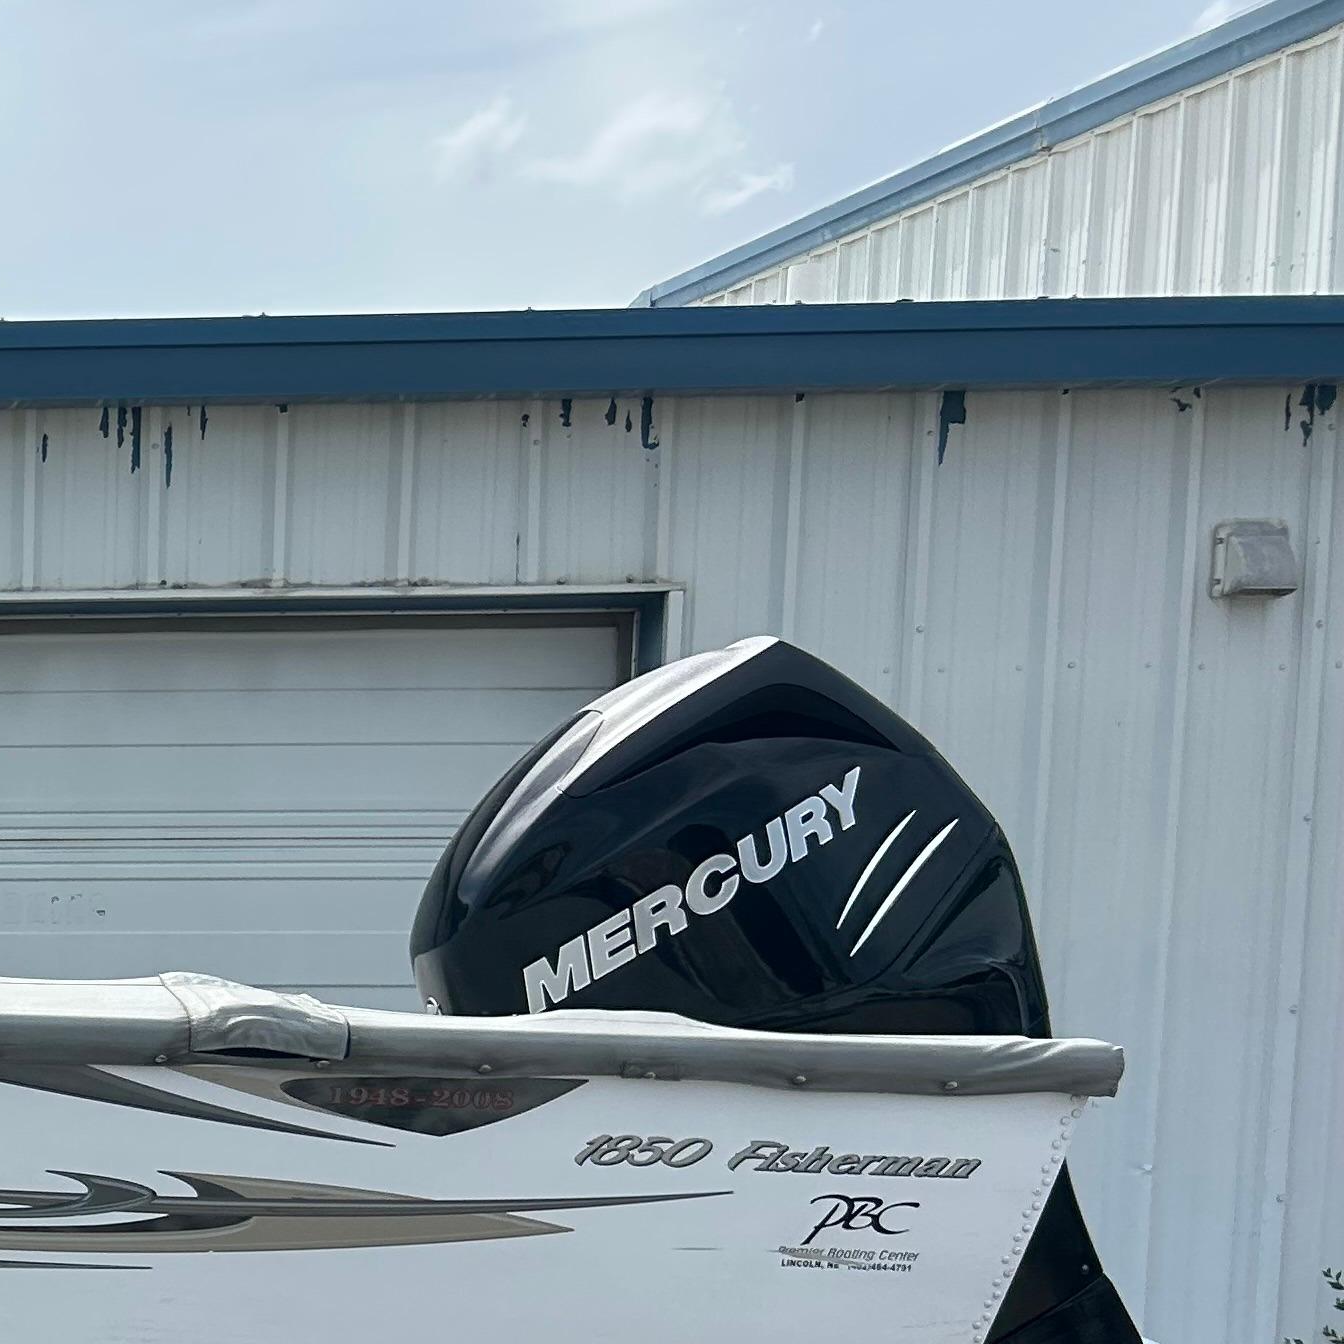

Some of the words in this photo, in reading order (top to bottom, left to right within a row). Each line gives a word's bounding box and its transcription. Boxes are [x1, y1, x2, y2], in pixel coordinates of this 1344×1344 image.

[521, 766, 862, 1014] MERCURY
[574, 1133, 713, 1169] 1850
[727, 1140, 983, 1179] Fisherman
[878, 1249, 920, 1261] Center
